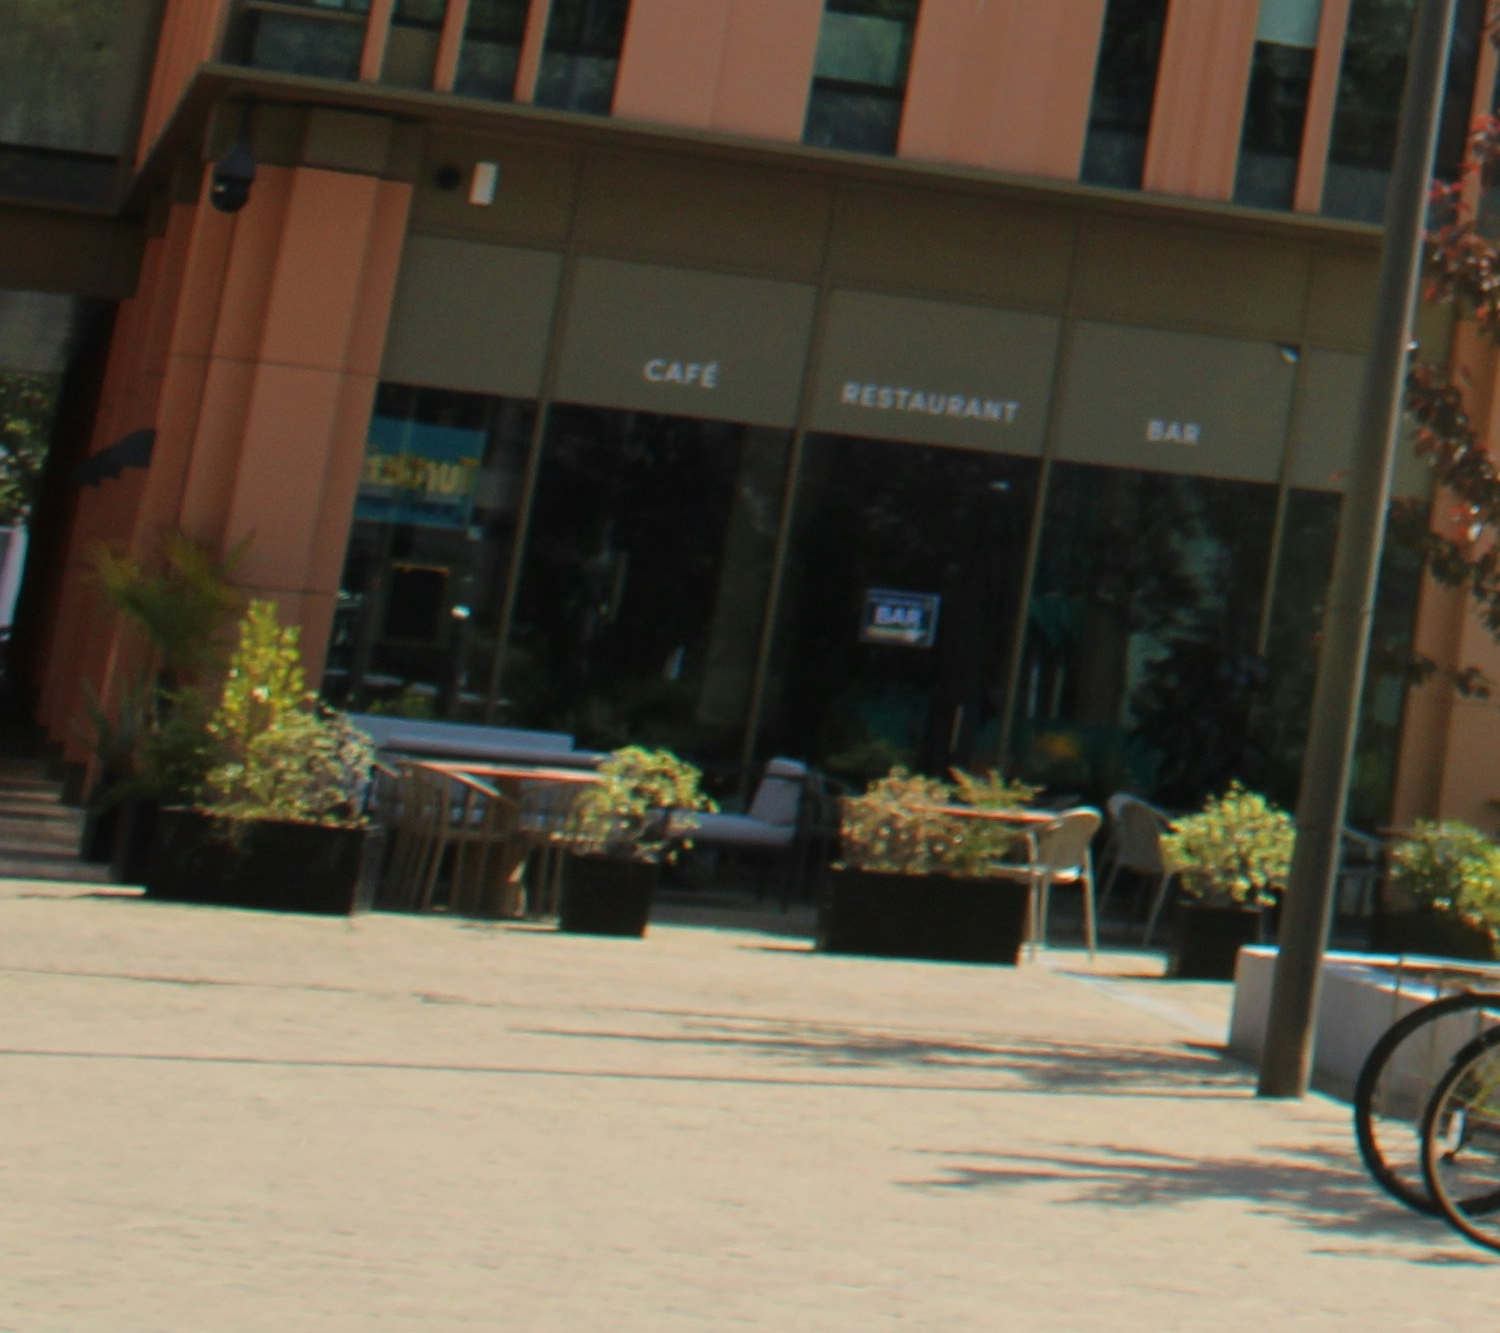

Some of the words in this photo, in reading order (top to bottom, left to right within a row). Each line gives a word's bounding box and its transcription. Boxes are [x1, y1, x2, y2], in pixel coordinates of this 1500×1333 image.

[643, 358, 719, 389] CAFÉ
[841, 382, 1021, 424] RESTAURANT
[1146, 419, 1201, 445] BAR
[873, 604, 922, 627] BAR
